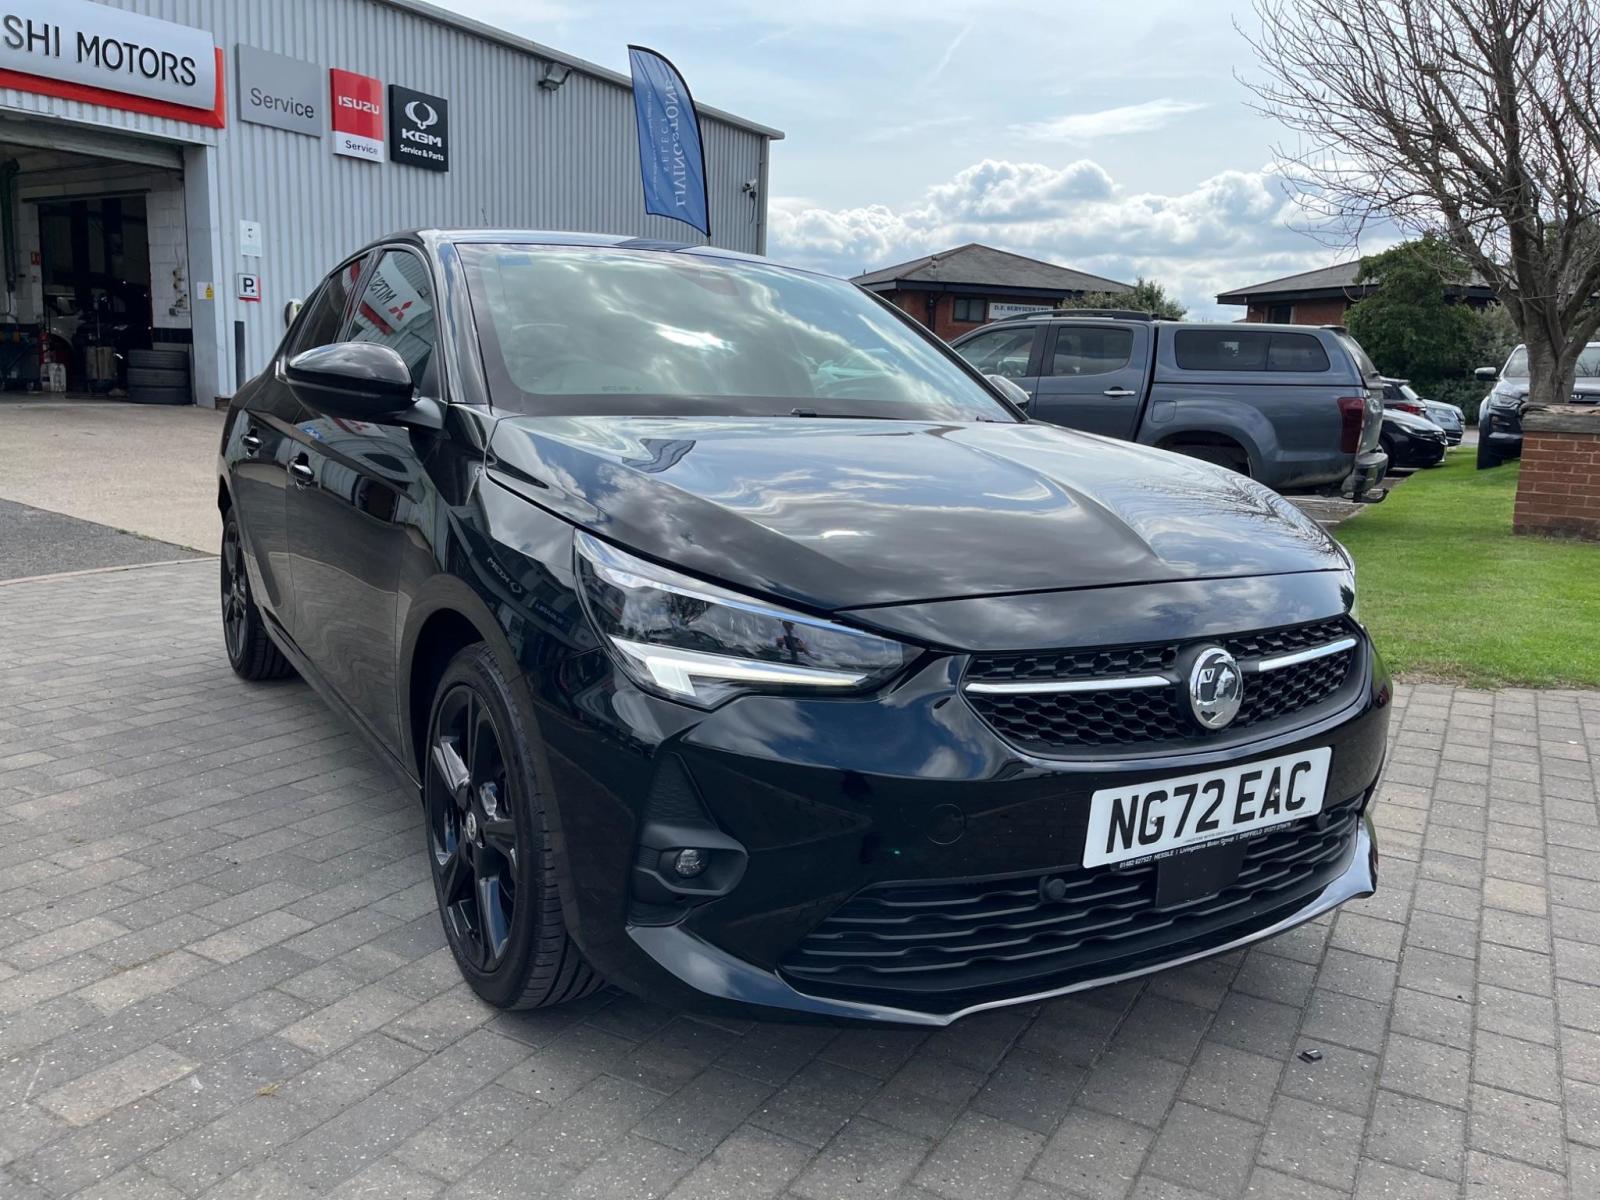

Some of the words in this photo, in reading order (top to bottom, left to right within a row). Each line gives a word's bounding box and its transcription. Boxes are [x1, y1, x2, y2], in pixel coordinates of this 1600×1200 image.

[3, 14, 60, 57] SHI
[76, 31, 196, 87] MOTORS
[250, 87, 315, 119] Service
[338, 95, 380, 115] ISUZU
[401, 128, 442, 147] KGM
[345, 139, 379, 156] Service
[400, 144, 422, 157] Service
[422, 149, 428, 158] &
[428, 150, 444, 162] Parts
[242, 277, 254, 293] P
[1105, 778, 1226, 854] NG72
[1232, 760, 1312, 825] EAC
